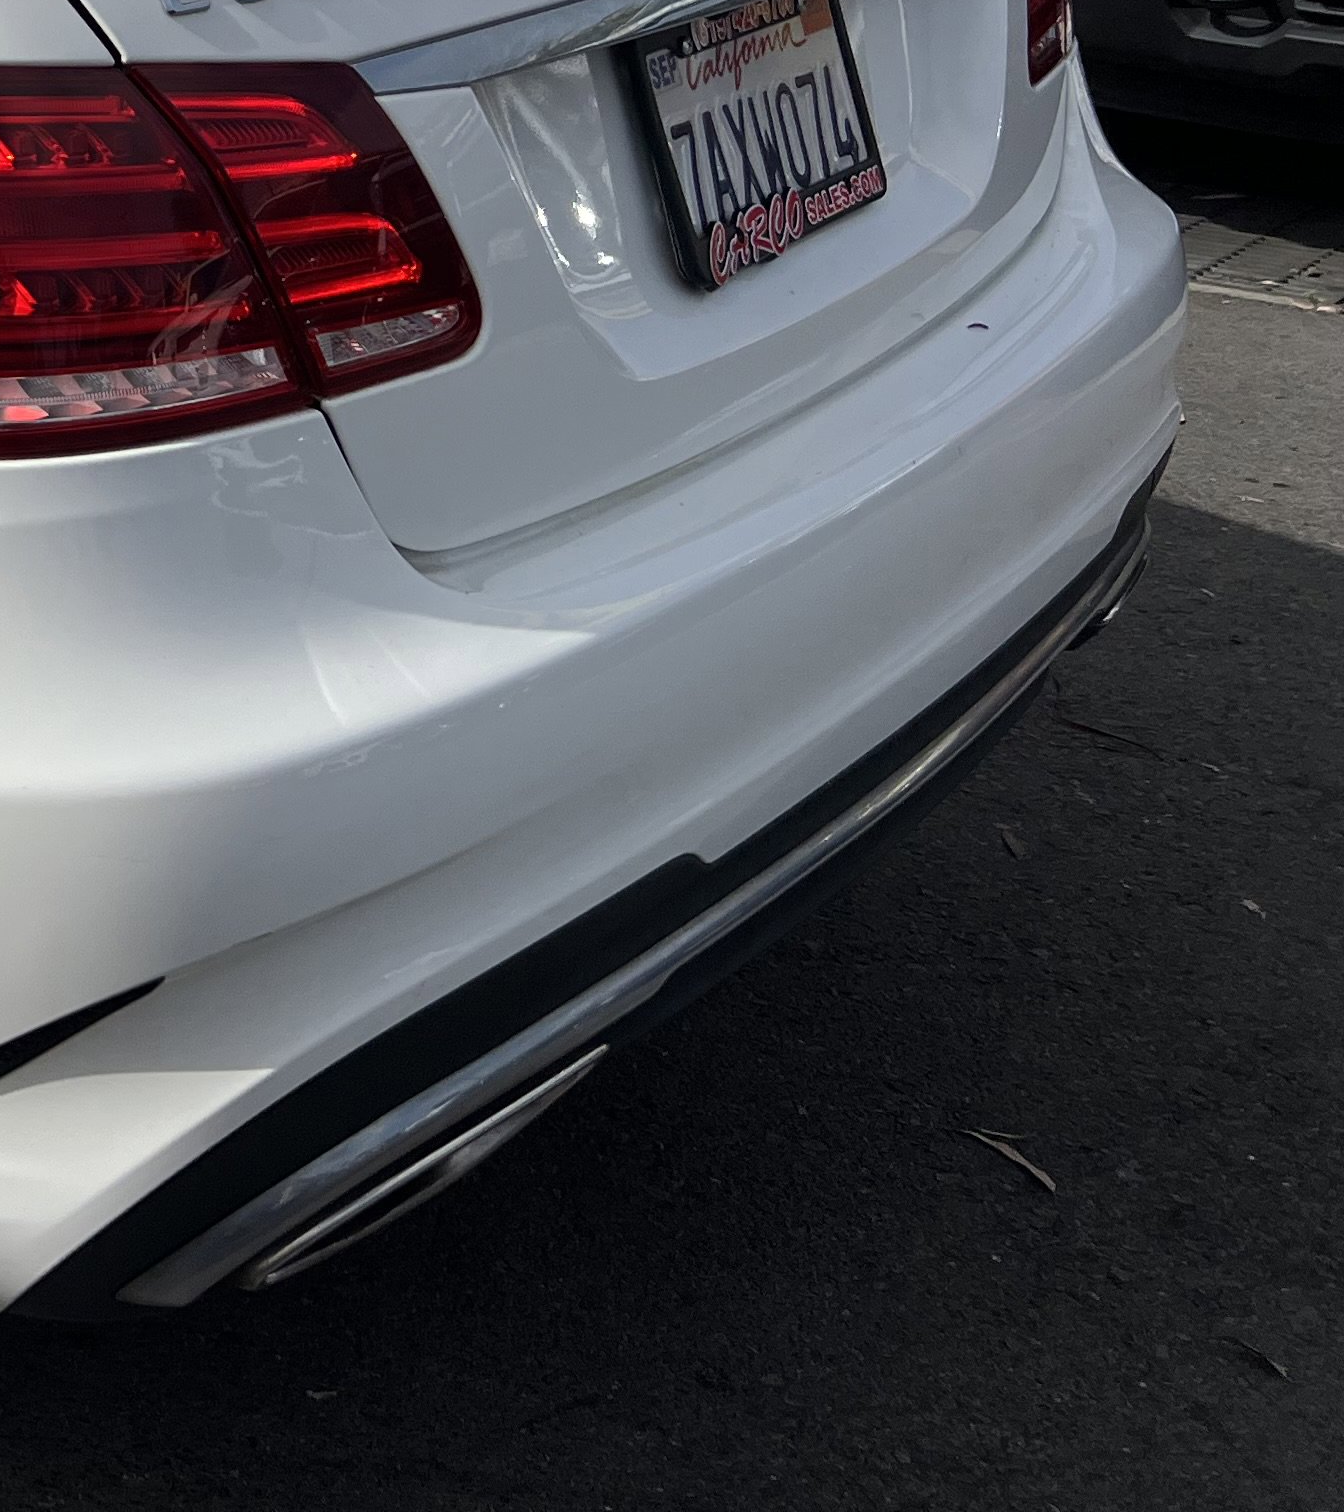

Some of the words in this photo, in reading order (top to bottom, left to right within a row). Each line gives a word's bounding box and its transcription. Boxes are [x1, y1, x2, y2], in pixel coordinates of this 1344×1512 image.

[686, 23, 806, 90] California
[669, 65, 860, 230] 7AXW074
[710, 188, 804, 286] CARCO
[805, 165, 883, 225] SALES.COM
